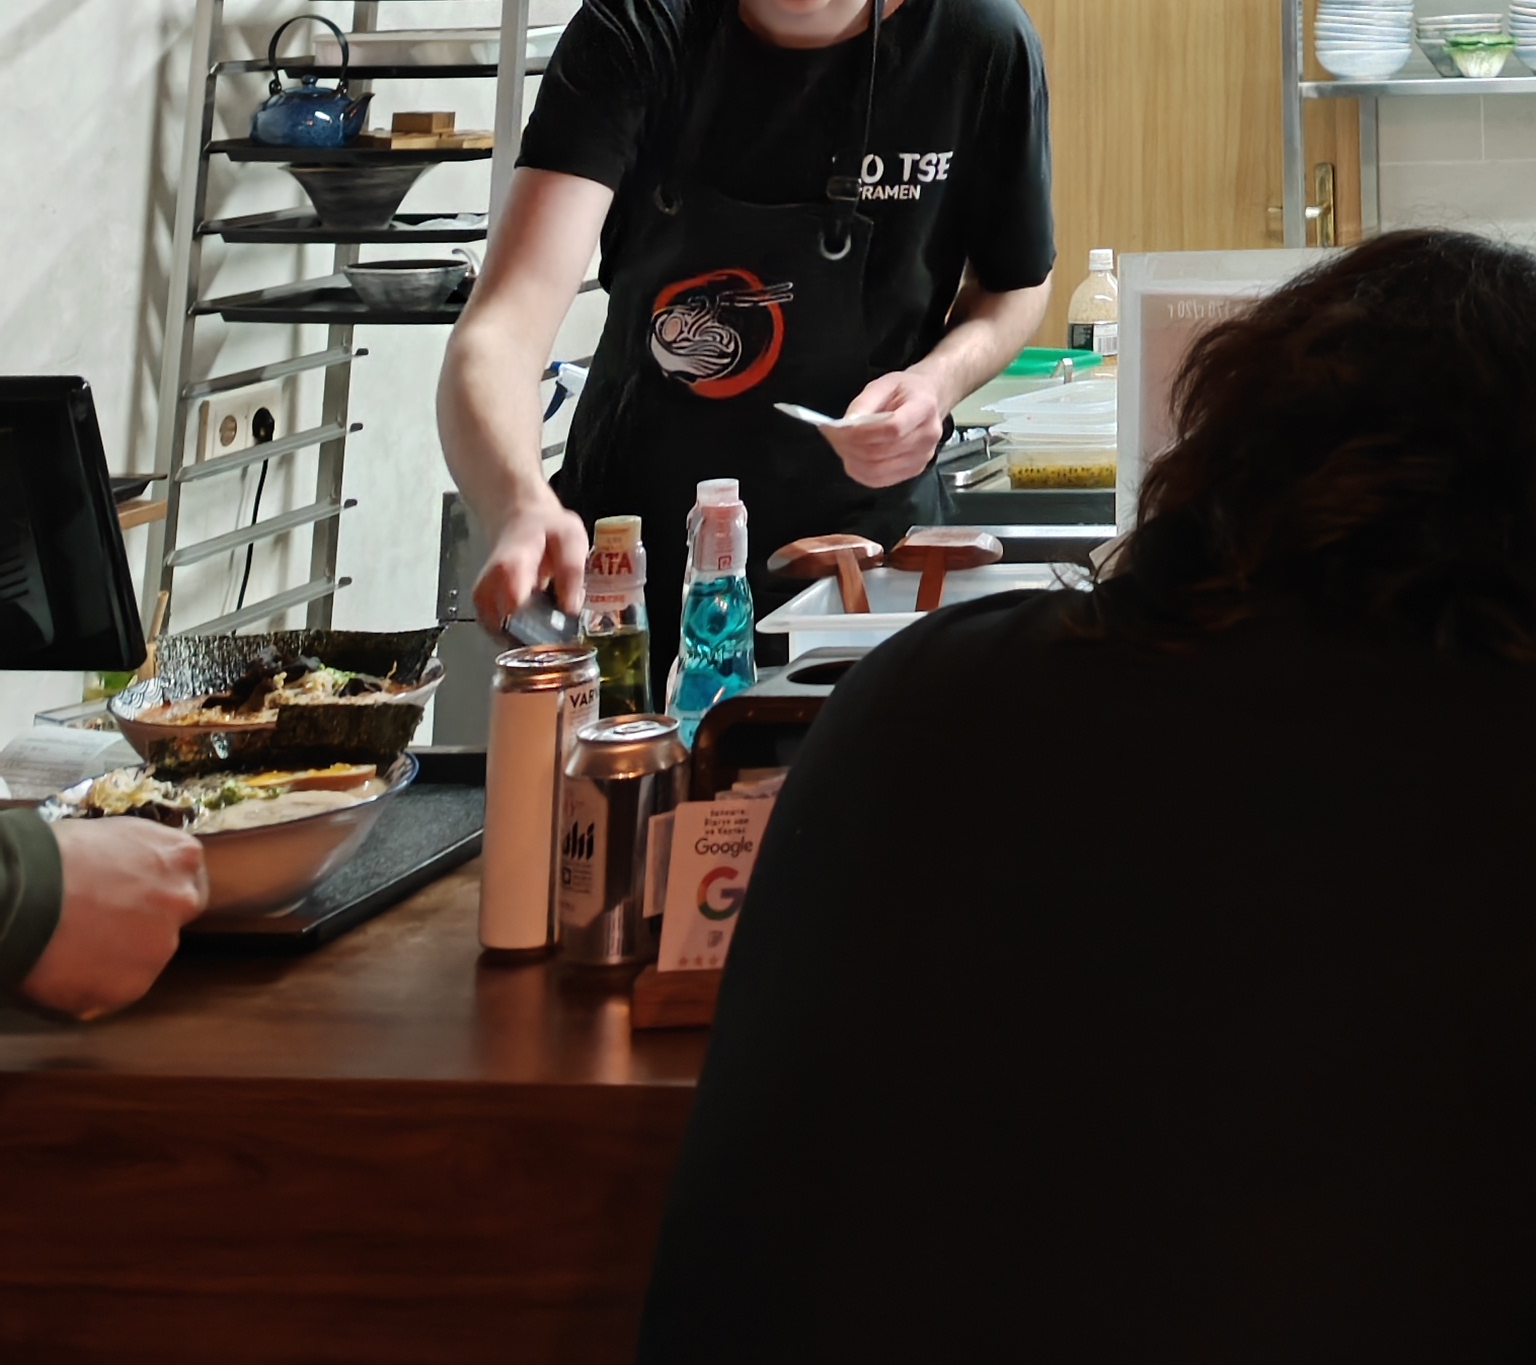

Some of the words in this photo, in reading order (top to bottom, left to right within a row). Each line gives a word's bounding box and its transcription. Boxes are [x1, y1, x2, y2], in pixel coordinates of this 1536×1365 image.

[898, 150, 954, 183] TSE
[861, 185, 921, 200] RAMEN
[694, 835, 753, 858] Google
